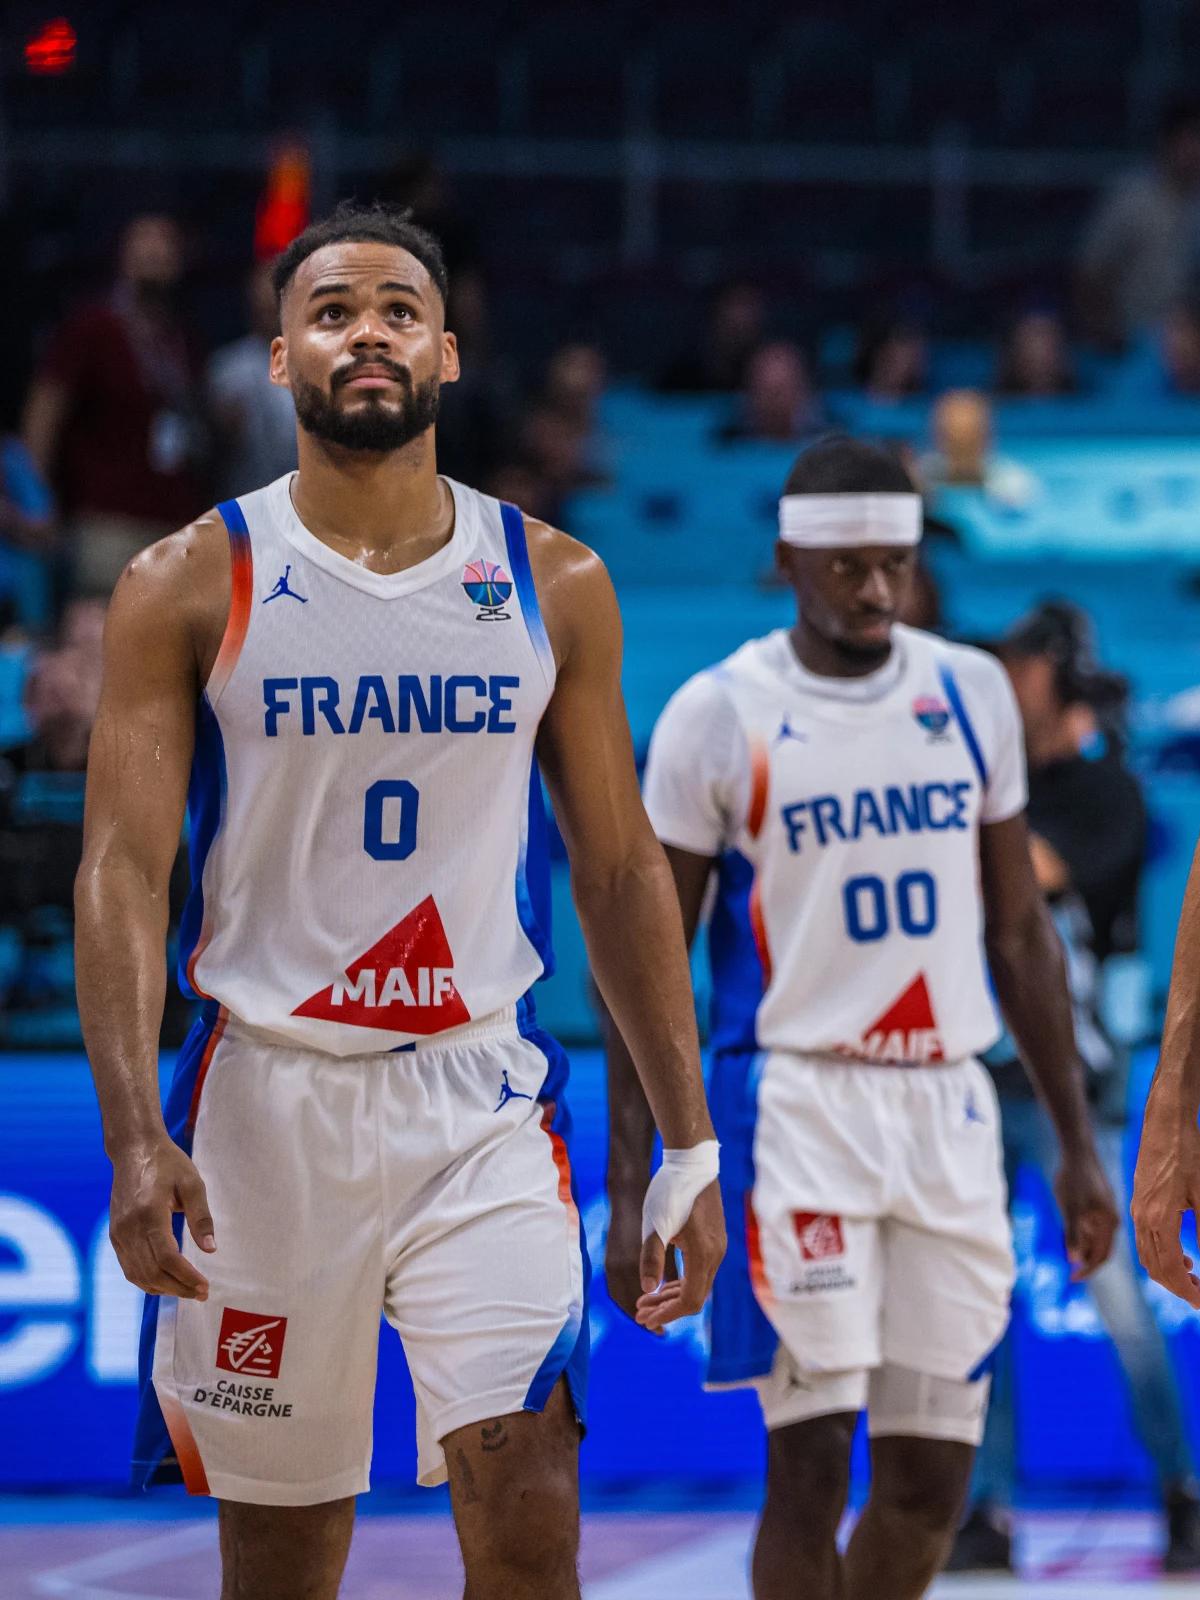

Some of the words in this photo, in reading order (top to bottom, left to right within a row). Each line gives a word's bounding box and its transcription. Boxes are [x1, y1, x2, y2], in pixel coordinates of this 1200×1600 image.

[263, 674, 521, 737] FRANCE
[363, 780, 419, 861] 0
[781, 781, 972, 855] FRANCE
[843, 869, 937, 943] 00
[329, 966, 455, 1007] MAIF
[193, 1388, 293, 1418] D'EPARGNE
[216, 1380, 274, 1401] CAISSE
